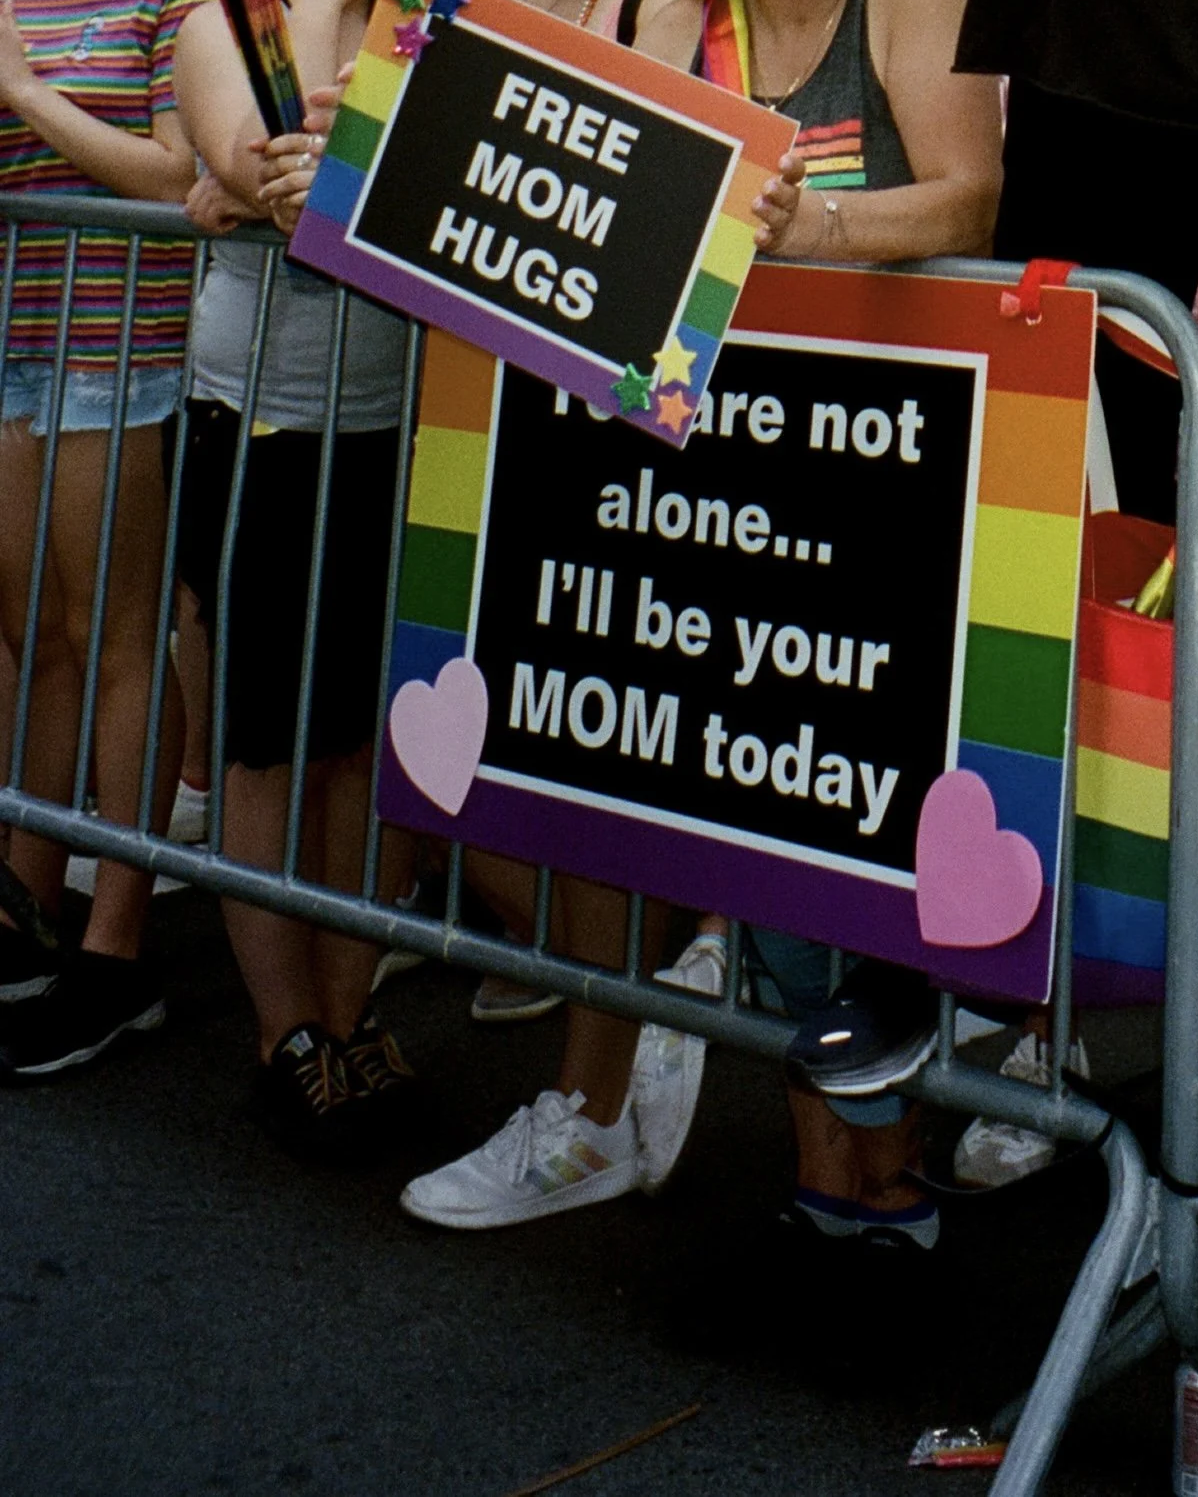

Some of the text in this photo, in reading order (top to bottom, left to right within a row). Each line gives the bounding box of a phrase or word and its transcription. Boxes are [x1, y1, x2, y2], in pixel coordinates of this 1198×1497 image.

[493, 72, 640, 175] FREE
[464, 140, 617, 247] MOM
[429, 206, 599, 321] HUGS
[809, 399, 925, 463] not
[597, 468, 832, 564] alone...
[536, 559, 890, 691] I'll be your
[508, 662, 900, 835] MOM today
